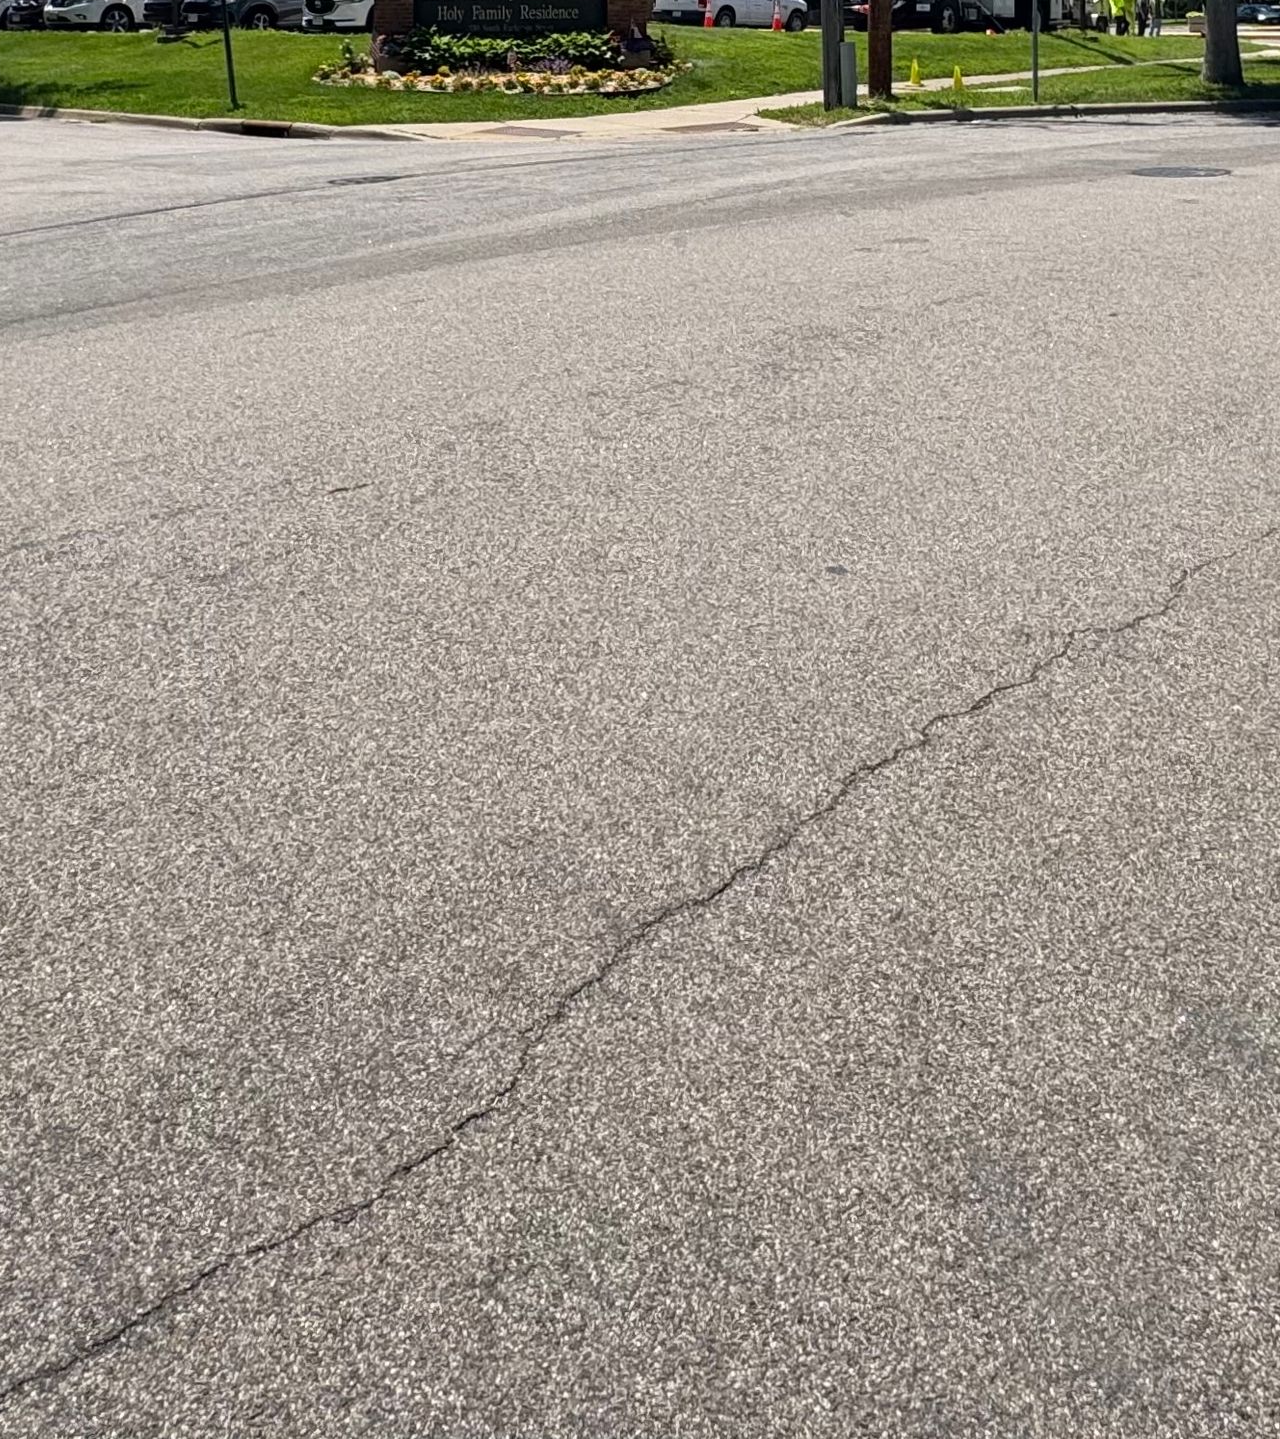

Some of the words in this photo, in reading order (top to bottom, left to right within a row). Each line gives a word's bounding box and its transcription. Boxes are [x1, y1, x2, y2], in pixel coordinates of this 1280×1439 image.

[437, 5, 464, 23] Holy
[472, 5, 512, 23] Family
[520, 4, 579, 20] Residence
